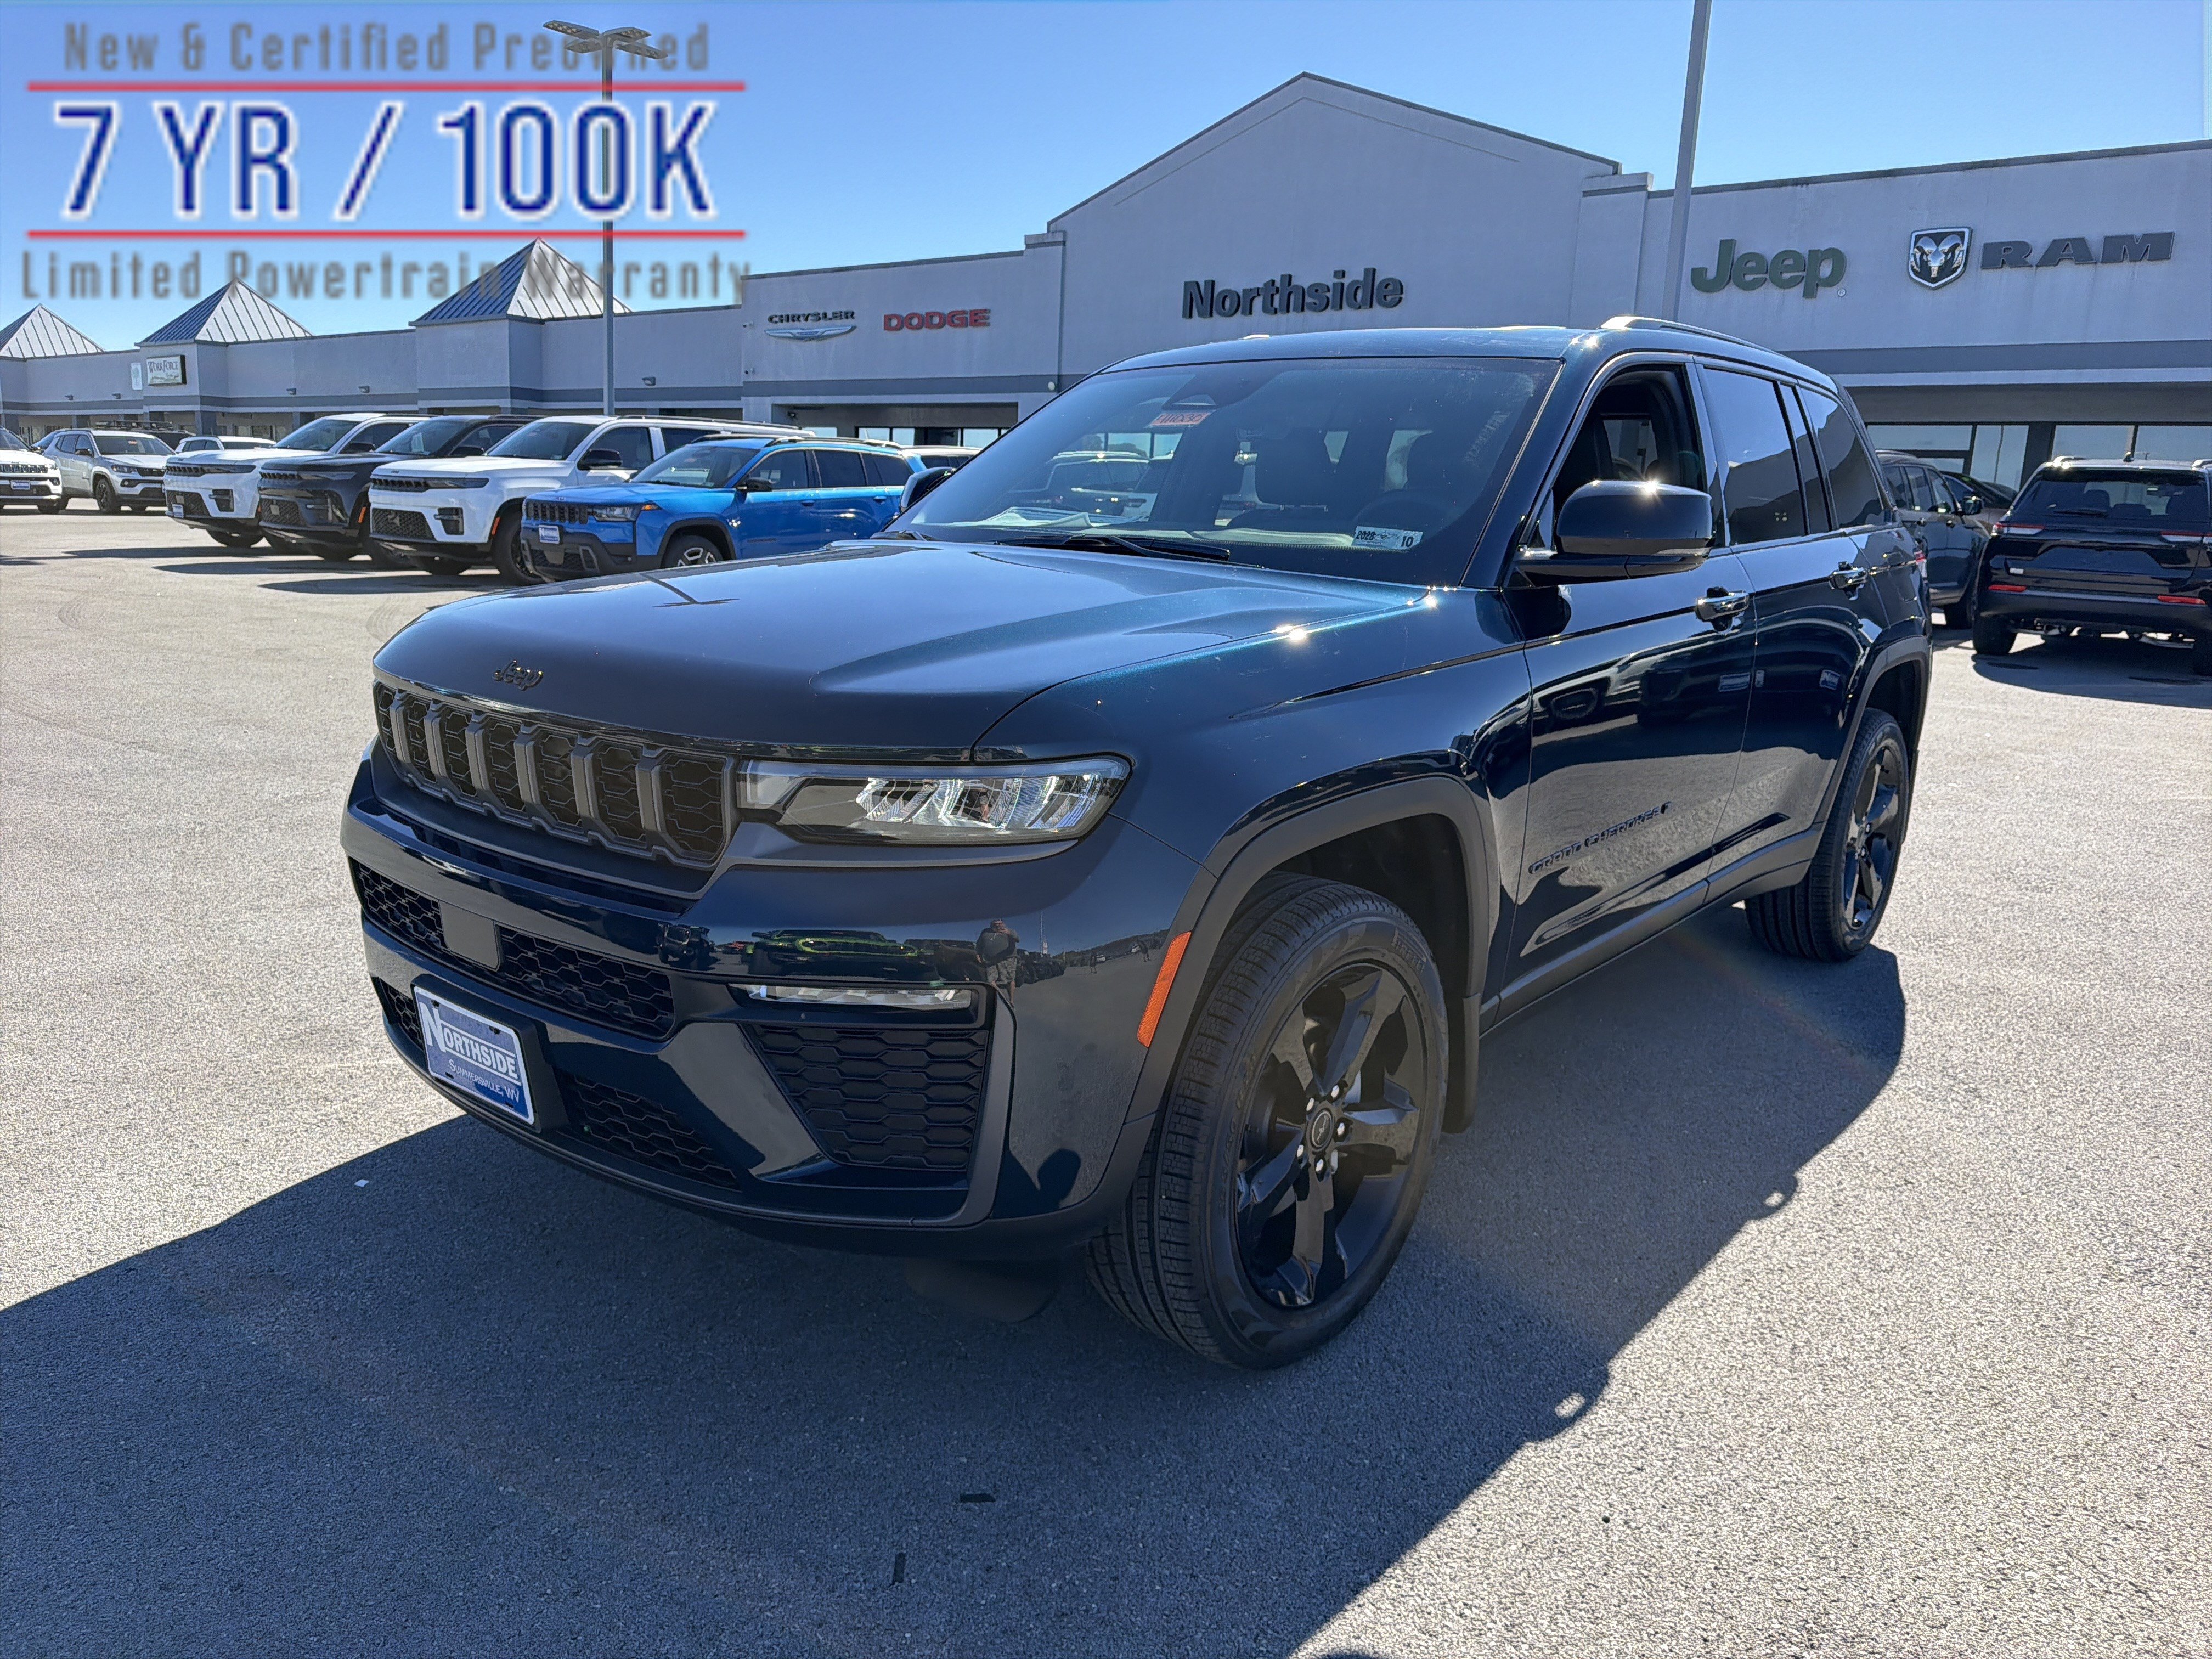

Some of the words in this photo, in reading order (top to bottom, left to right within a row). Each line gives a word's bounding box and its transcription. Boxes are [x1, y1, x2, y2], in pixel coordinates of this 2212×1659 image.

[1981, 231, 2175, 270] RAM
[1691, 239, 1847, 298] Jeep
[1182, 267, 1403, 319] Northside
[768, 310, 855, 324] CHRYSLER
[884, 308, 991, 331] DODGE
[1401, 535, 1414, 548] 10
[419, 1002, 518, 1080] NORTHSIDE
[505, 1086, 520, 1103] WV
